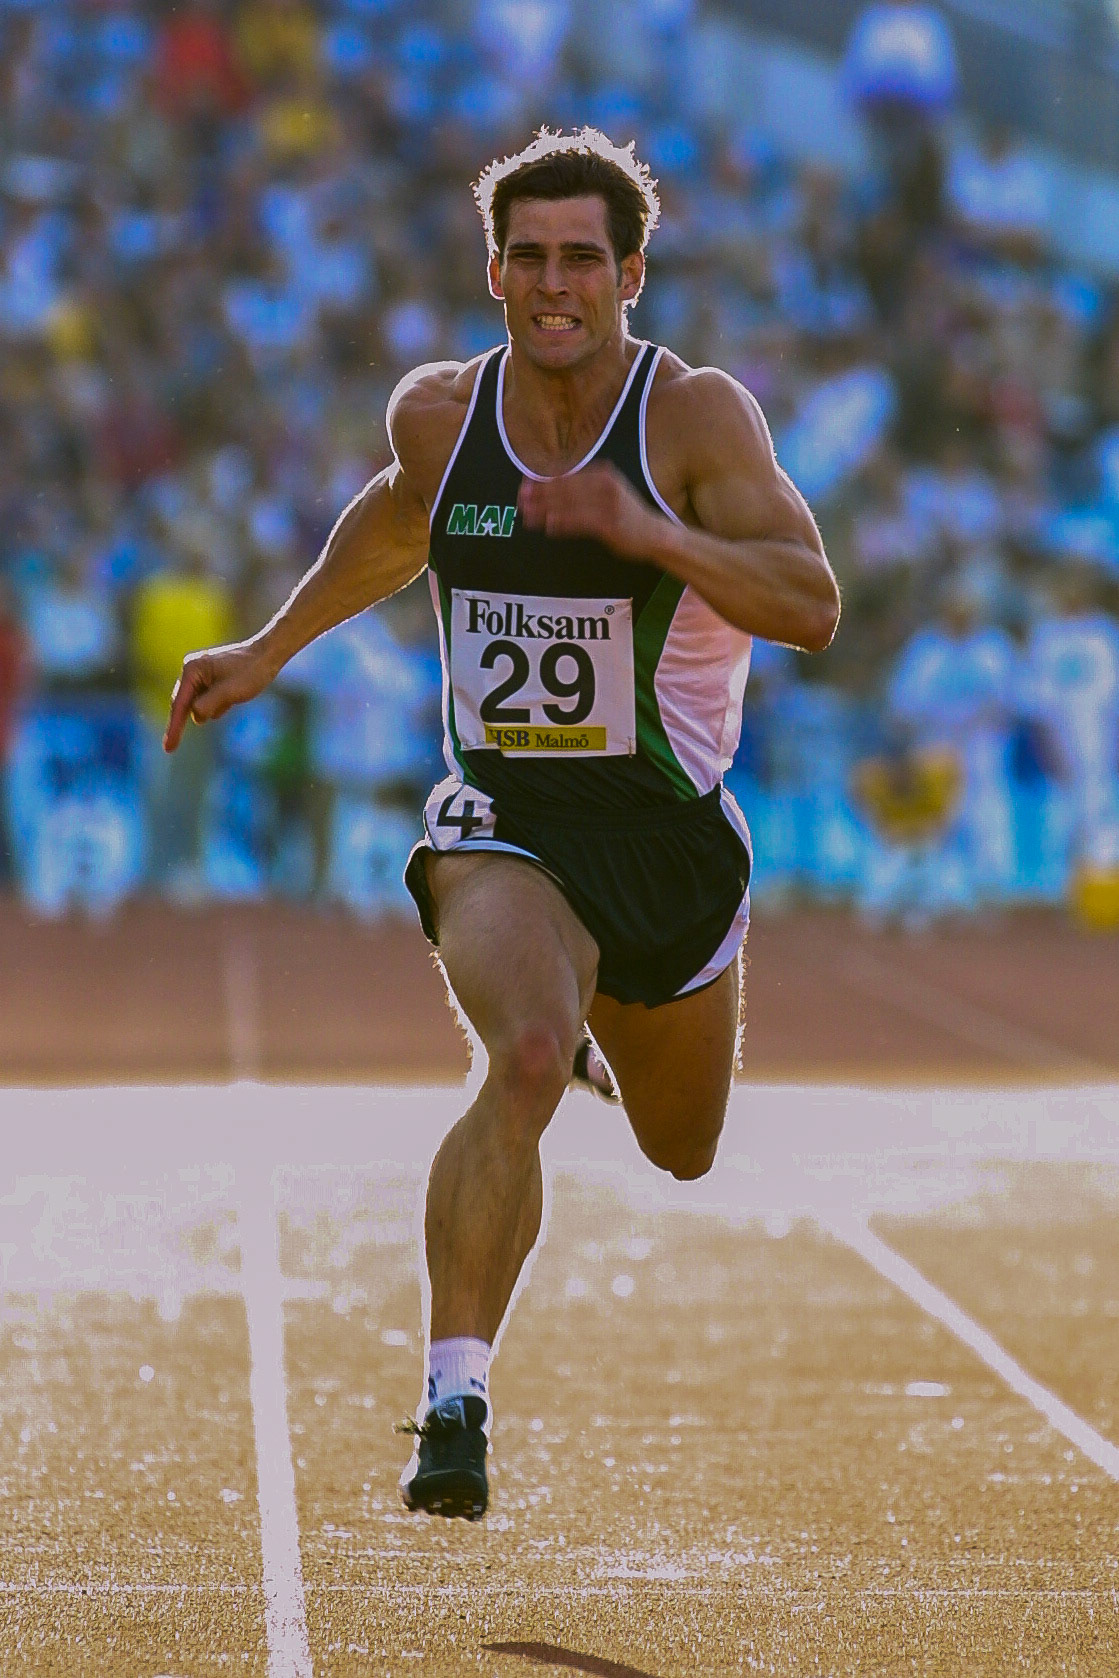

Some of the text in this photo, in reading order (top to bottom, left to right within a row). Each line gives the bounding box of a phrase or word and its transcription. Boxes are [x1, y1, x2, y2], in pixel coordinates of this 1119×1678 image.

[465, 598, 612, 641] Folksam
[479, 639, 596, 726] 29
[436, 791, 484, 840] 4
